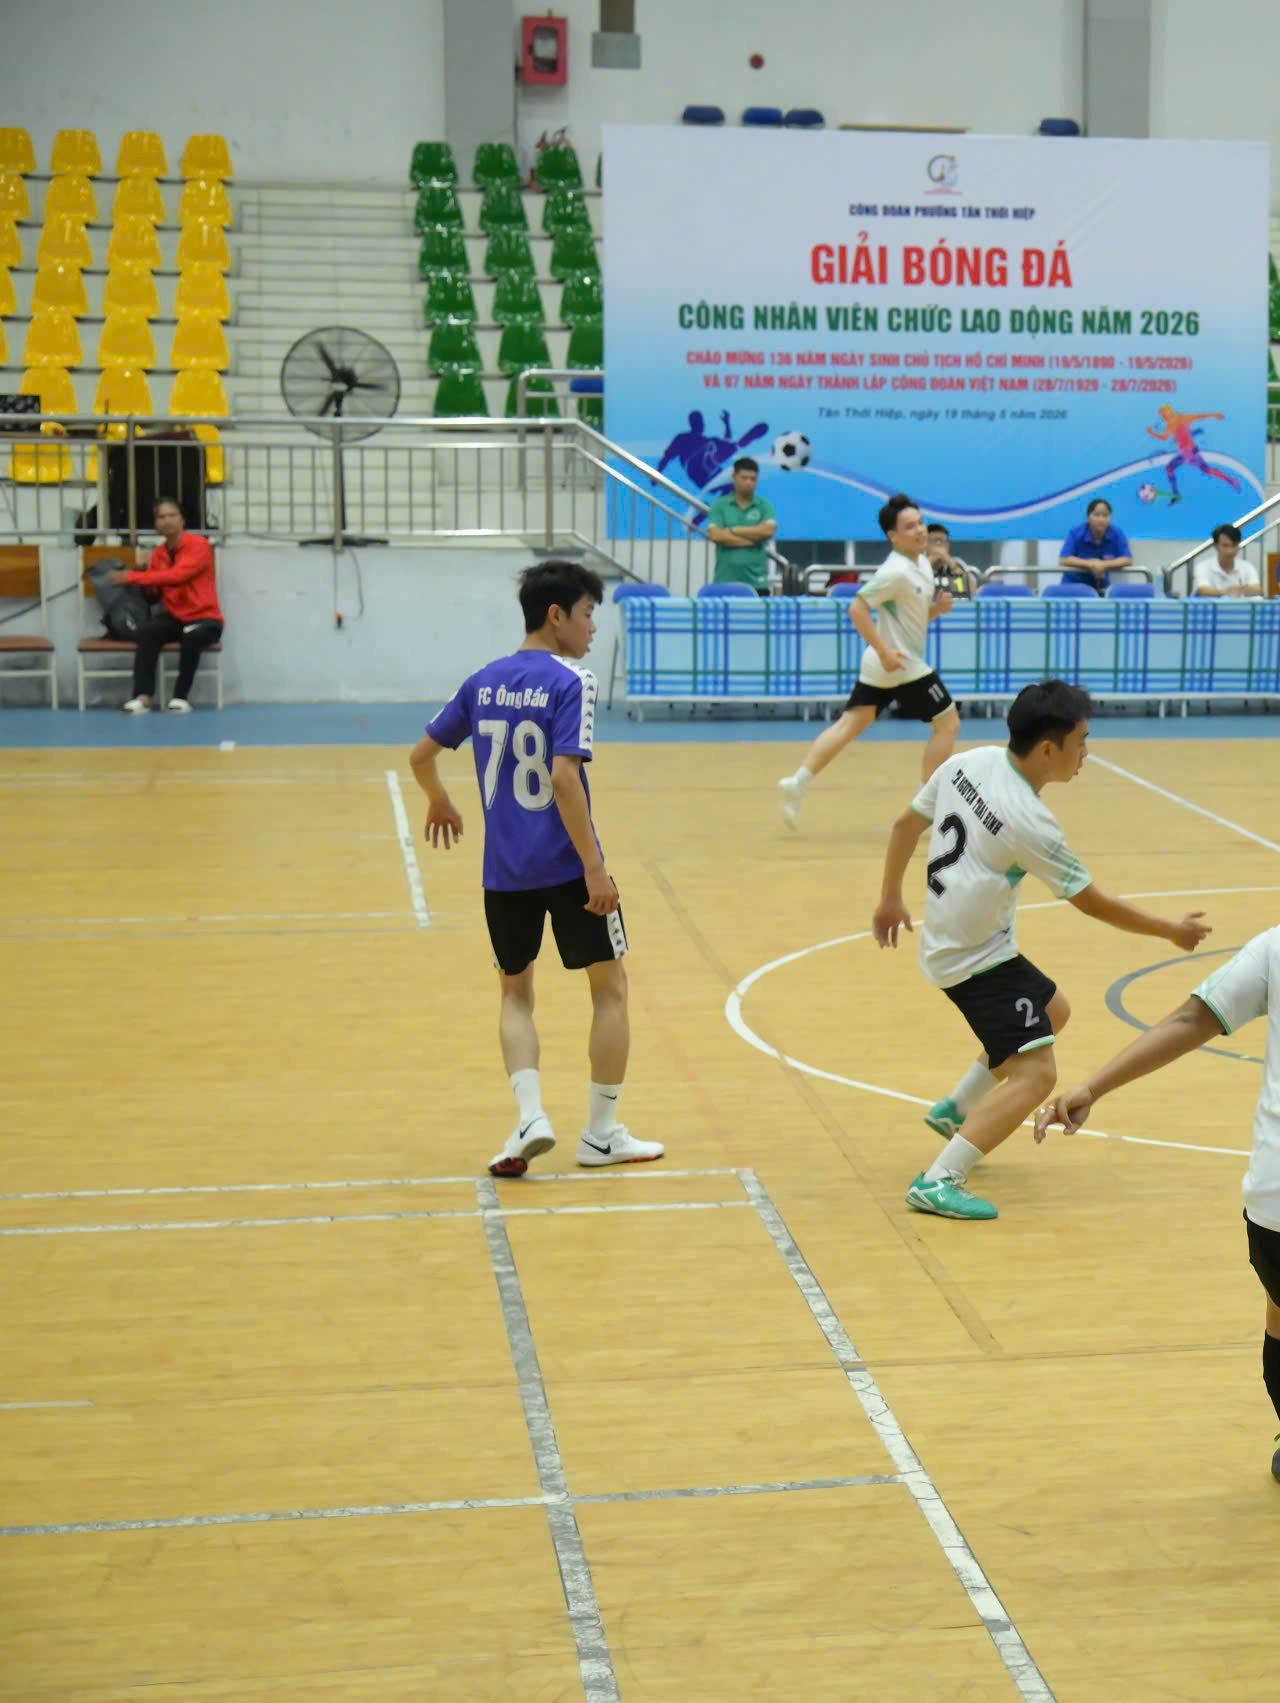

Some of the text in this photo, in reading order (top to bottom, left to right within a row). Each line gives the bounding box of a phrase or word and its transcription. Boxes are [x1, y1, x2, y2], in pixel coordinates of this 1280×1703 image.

[810, 230, 1073, 288] GIẢI BÓNG ĐÁ
[678, 299, 1200, 339] CÔNG NHÂN VIÊN CHỨC LAO ĐỘNG NĂM 2026
[796, 350, 827, 367] NĂM
[830, 349, 865, 367] NGÀY
[869, 353, 900, 368] SINH
[1011, 355, 1046, 369] MINH
[703, 373, 721, 388] VÀ
[743, 373, 775, 389] NĂM
[778, 373, 813, 390] NGÀY
[817, 374, 860, 390] THÀNH
[891, 374, 927, 391] CÔNG
[969, 374, 995, 394] VIỆT
[998, 377, 1029, 391] NAM
[477, 686, 492, 706] FC
[478, 719, 556, 812] 78
[927, 811, 968, 899] 2
[1015, 996, 1040, 1028] 2
